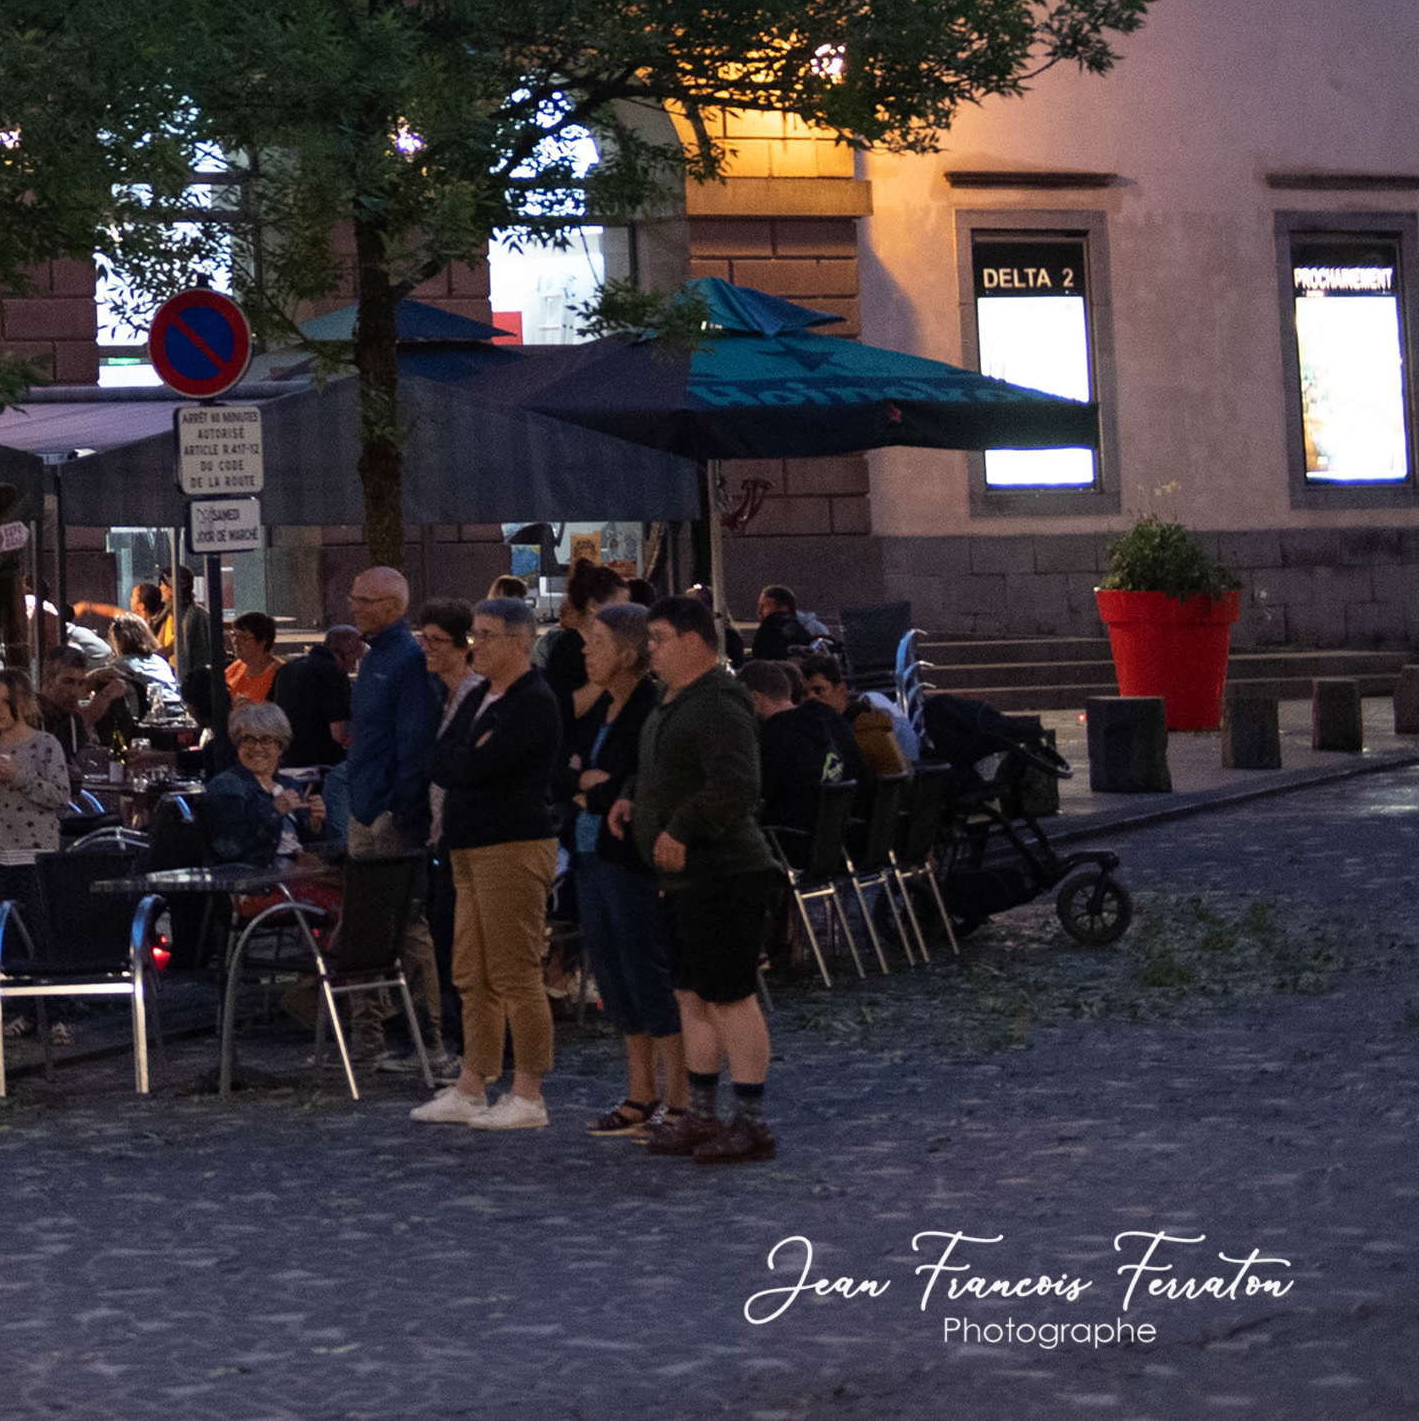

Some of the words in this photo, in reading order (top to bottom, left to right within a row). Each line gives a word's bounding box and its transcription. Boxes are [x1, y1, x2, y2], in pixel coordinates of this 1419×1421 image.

[983, 268, 1051, 288] DELTA
[1062, 268, 1074, 288] 2
[1293, 267, 1393, 290] PROCHAINEMENT
[222, 411, 258, 423] MINUTES
[184, 445, 218, 456] ARTICLE
[200, 460, 213, 471] DU
[219, 459, 244, 471] CODE
[190, 477, 203, 488] DE
[208, 476, 220, 487] LA
[224, 475, 255, 487] ROUTE
